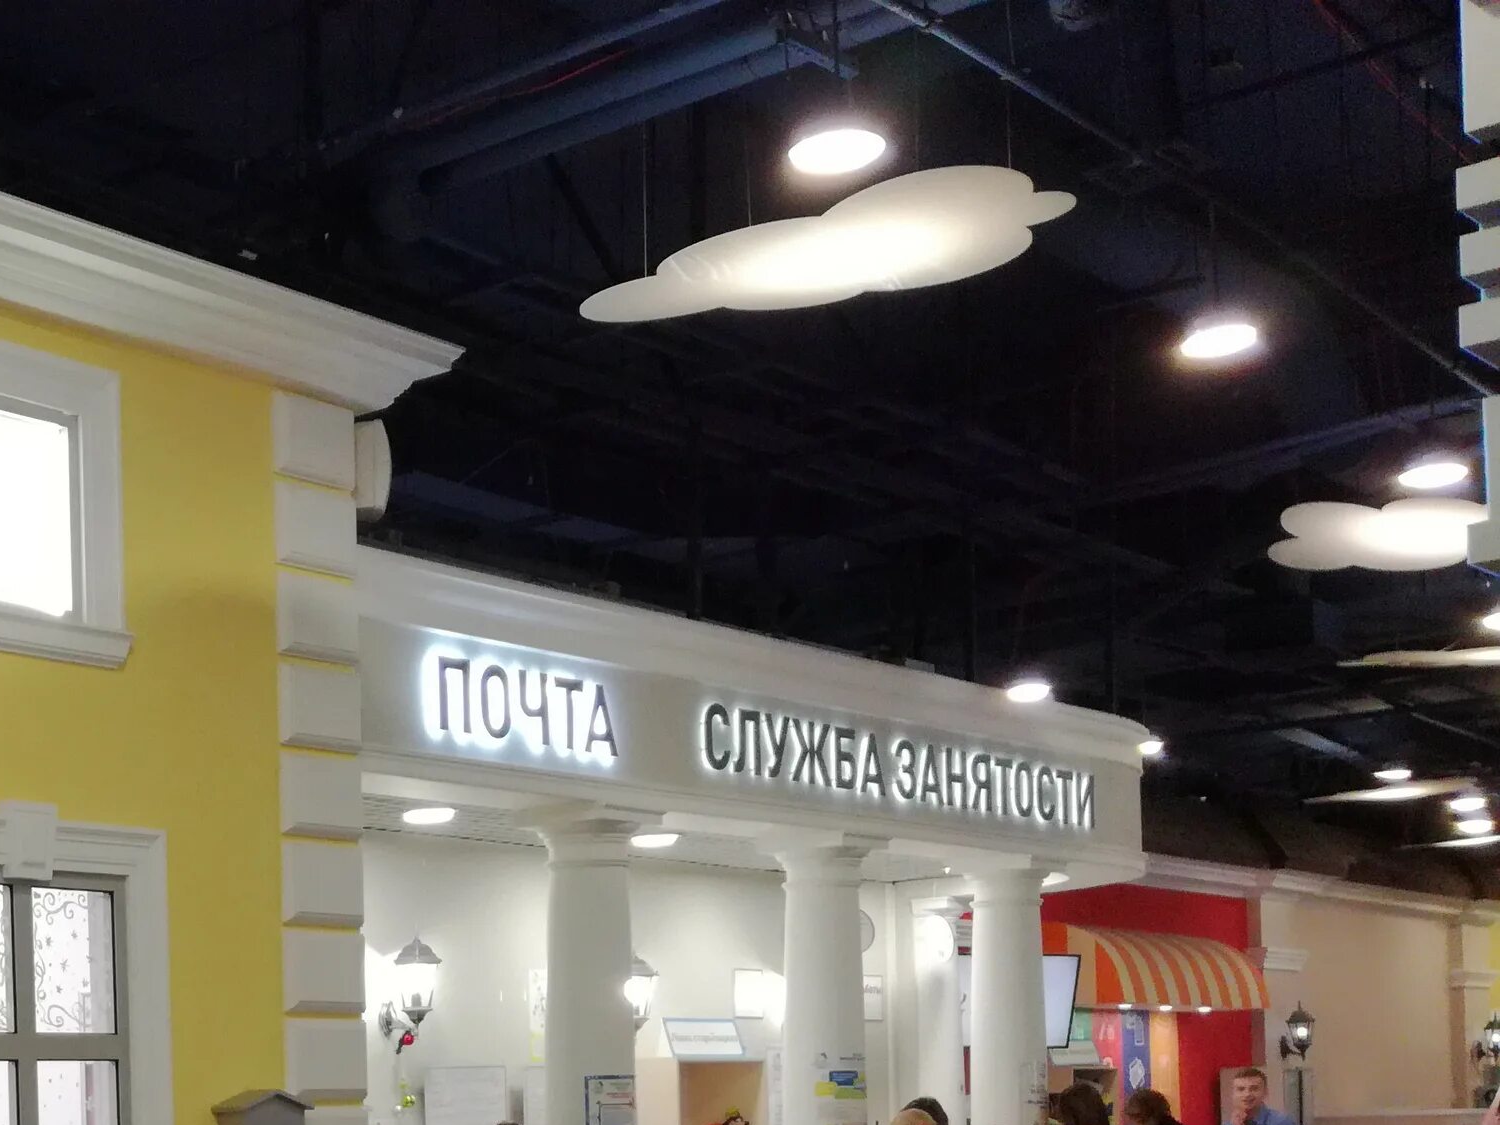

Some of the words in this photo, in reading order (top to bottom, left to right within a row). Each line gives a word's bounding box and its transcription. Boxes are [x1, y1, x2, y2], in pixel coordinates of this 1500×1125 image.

[435, 655, 620, 759] ПОЧТА
[702, 701, 887, 798] СЛУЖБА
[891, 737, 1097, 829] ЗАНЯТОСТИ
